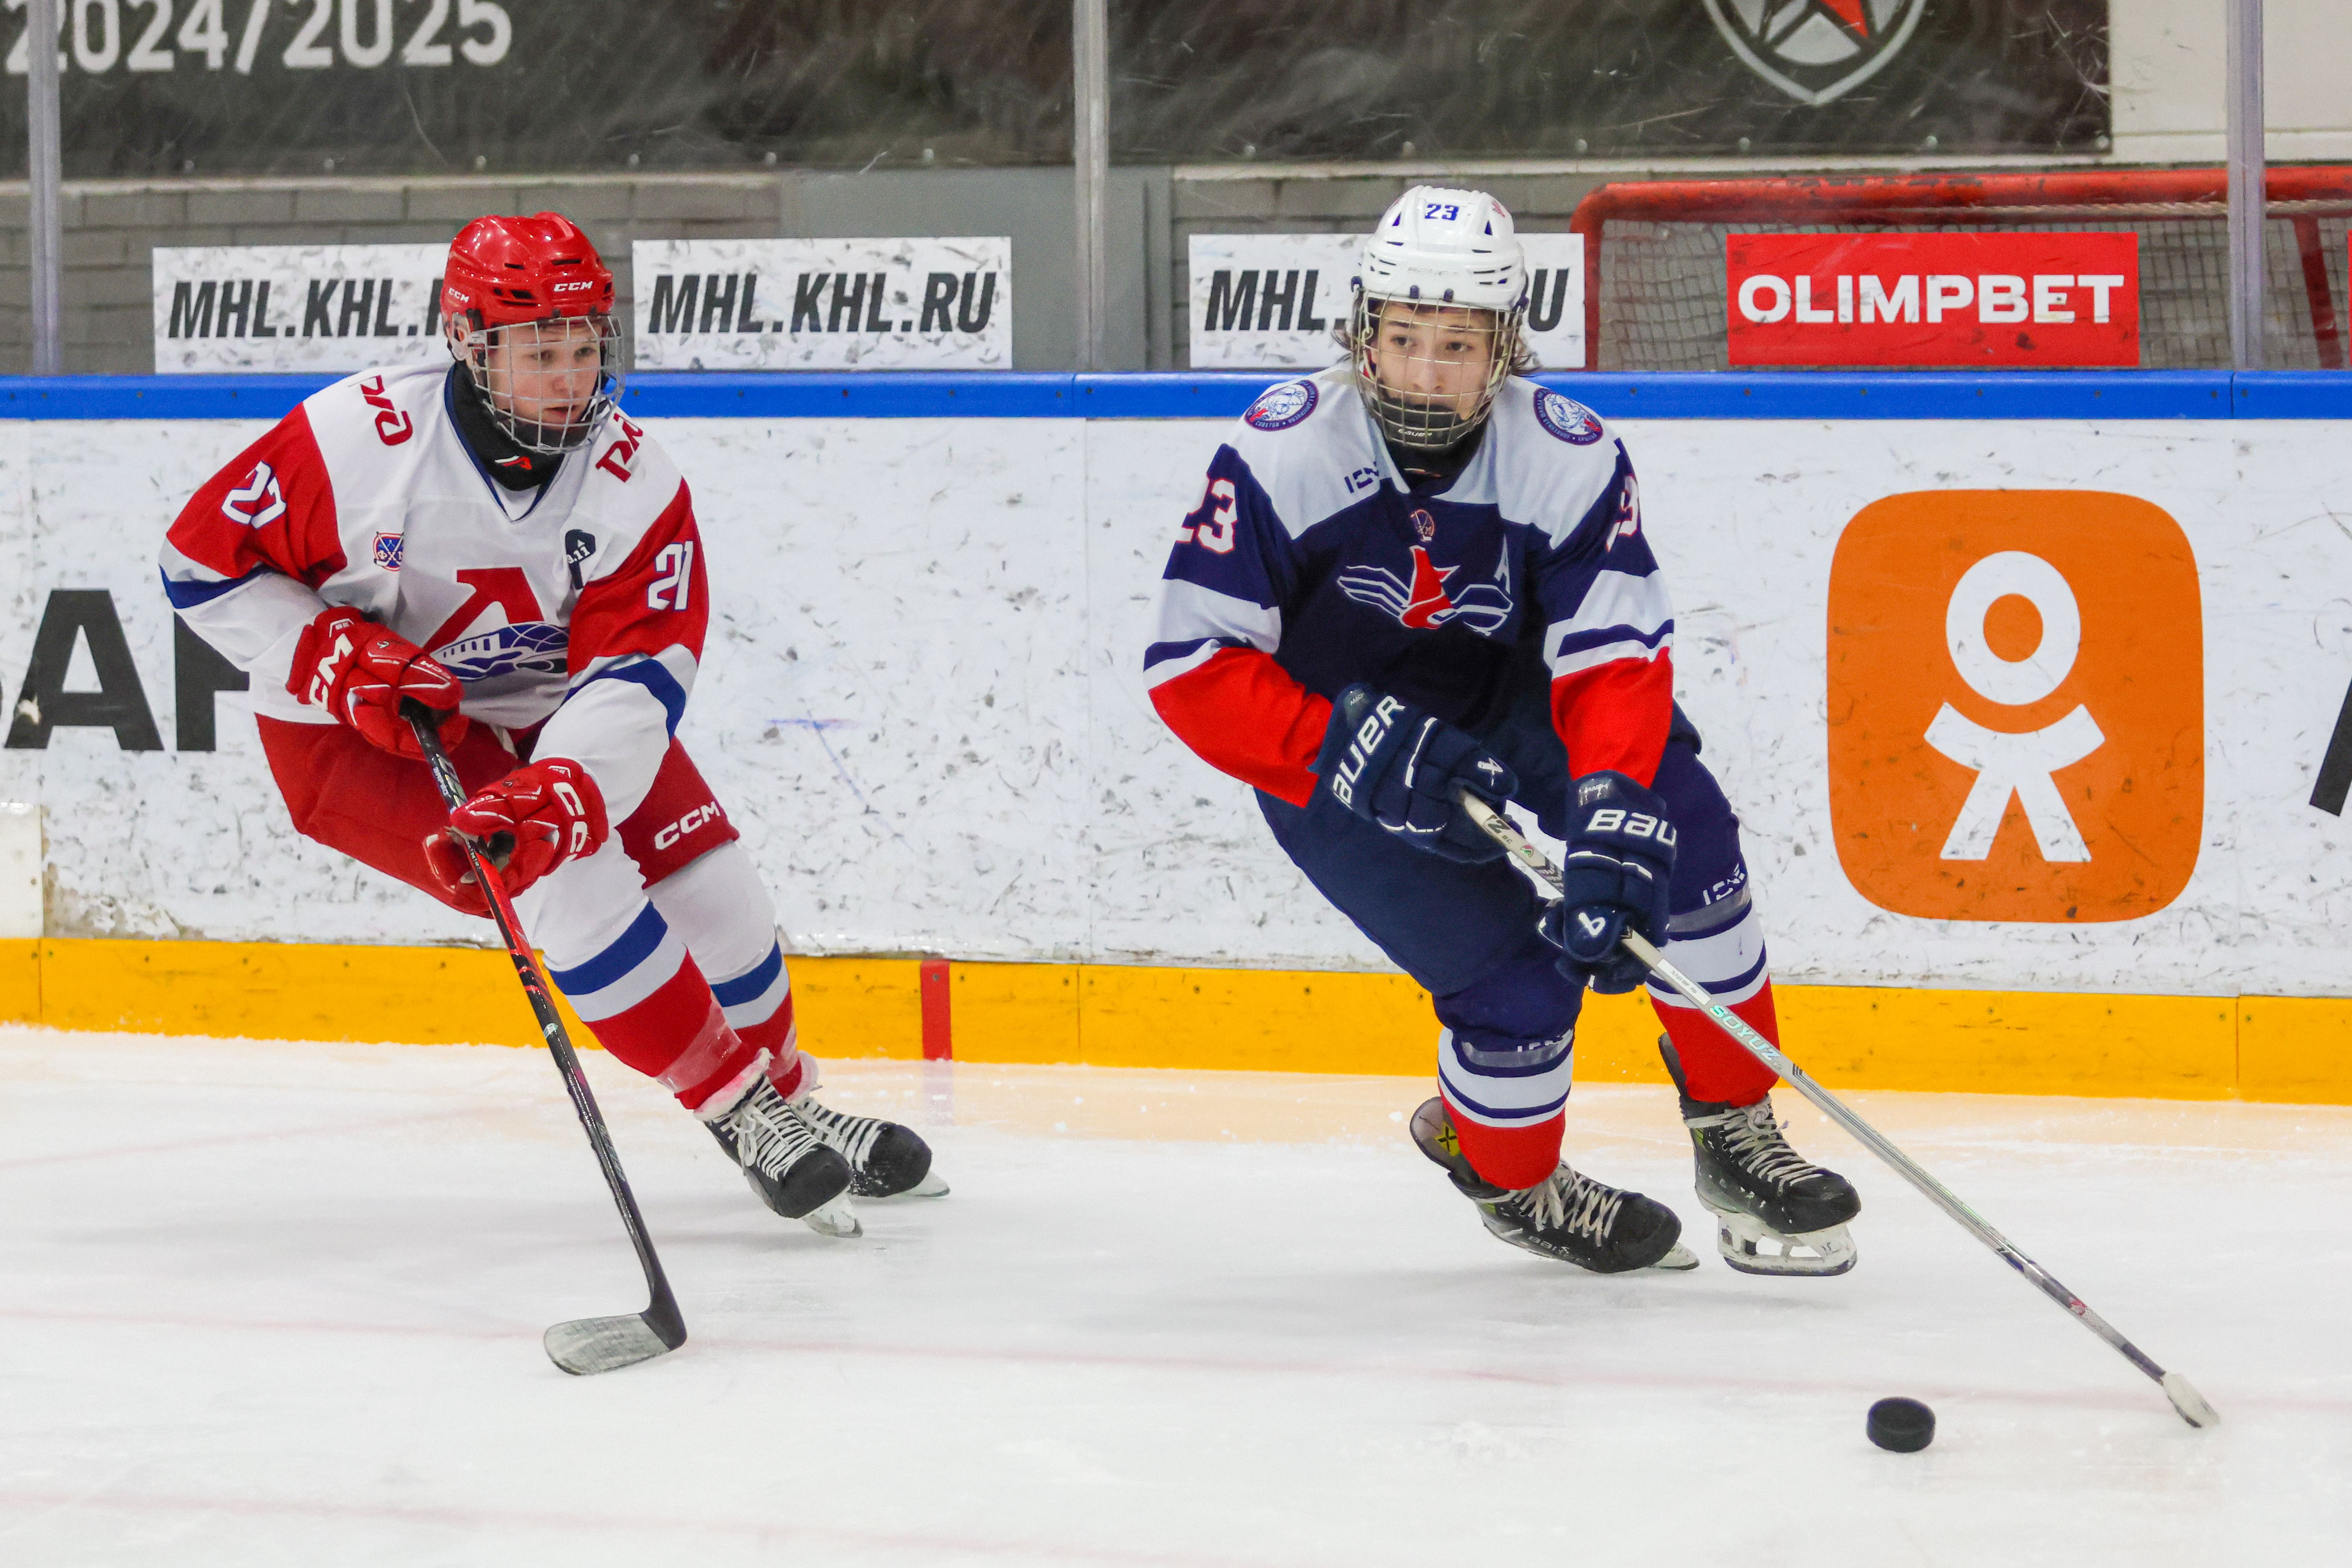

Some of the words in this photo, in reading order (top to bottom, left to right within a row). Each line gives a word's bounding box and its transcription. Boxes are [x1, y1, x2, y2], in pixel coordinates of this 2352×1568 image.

[1425, 204, 1459, 221] 23
[448, 287, 469, 303] CCM
[553, 280, 593, 292] CCM
[648, 272, 996, 334] MHL.KHL.RU
[1738, 274, 2125, 324] OLIMPBET
[221, 460, 287, 529] 21
[647, 540, 693, 611] 21
[1332, 695, 1406, 808] AUER
[552, 781, 588, 861] CC
[654, 801, 721, 851] CCM
[1709, 1004, 1782, 1061] SOYUZ
